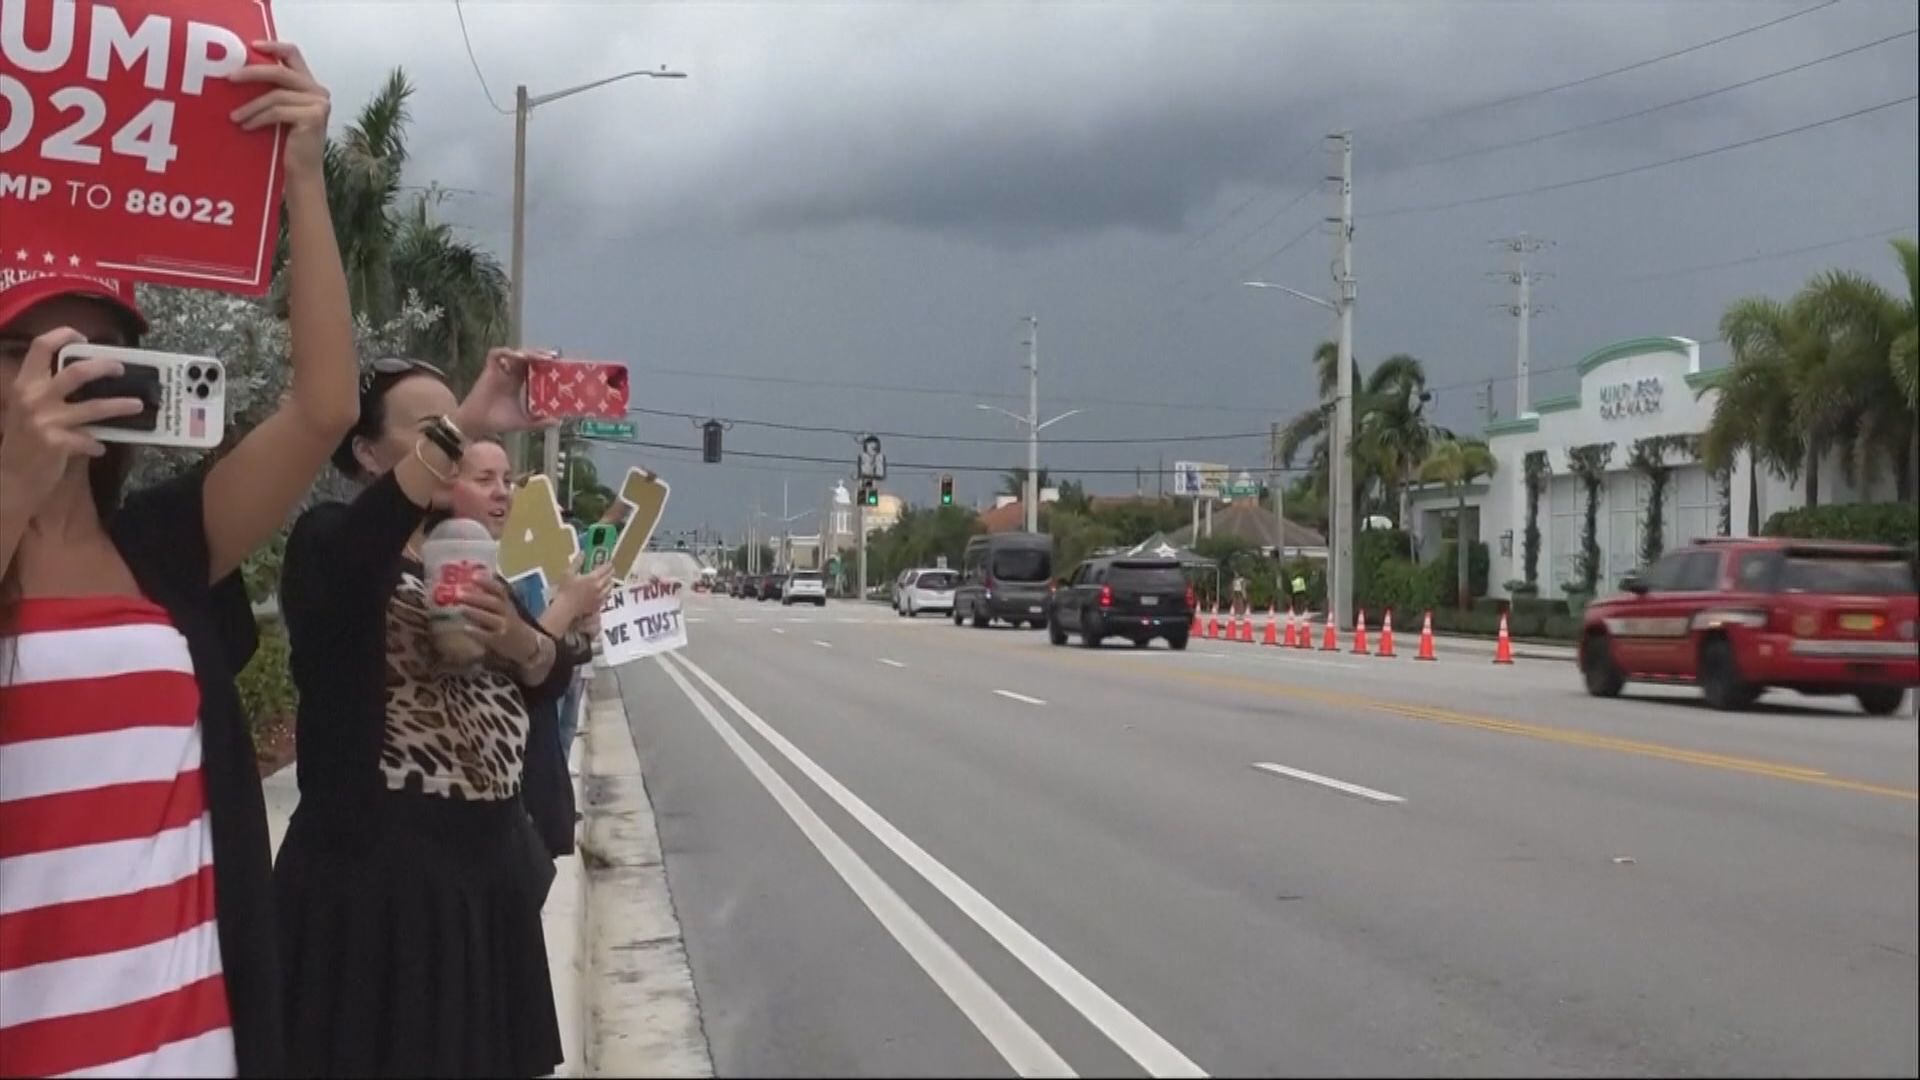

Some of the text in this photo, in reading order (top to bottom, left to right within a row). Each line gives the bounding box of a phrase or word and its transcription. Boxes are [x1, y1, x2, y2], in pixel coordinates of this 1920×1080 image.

[67, 180, 111, 209] TO
[125, 188, 235, 225] 88022
[629, 580, 682, 604] TRUMP
[604, 622, 630, 647] WE
[633, 610, 681, 637] TRUST
